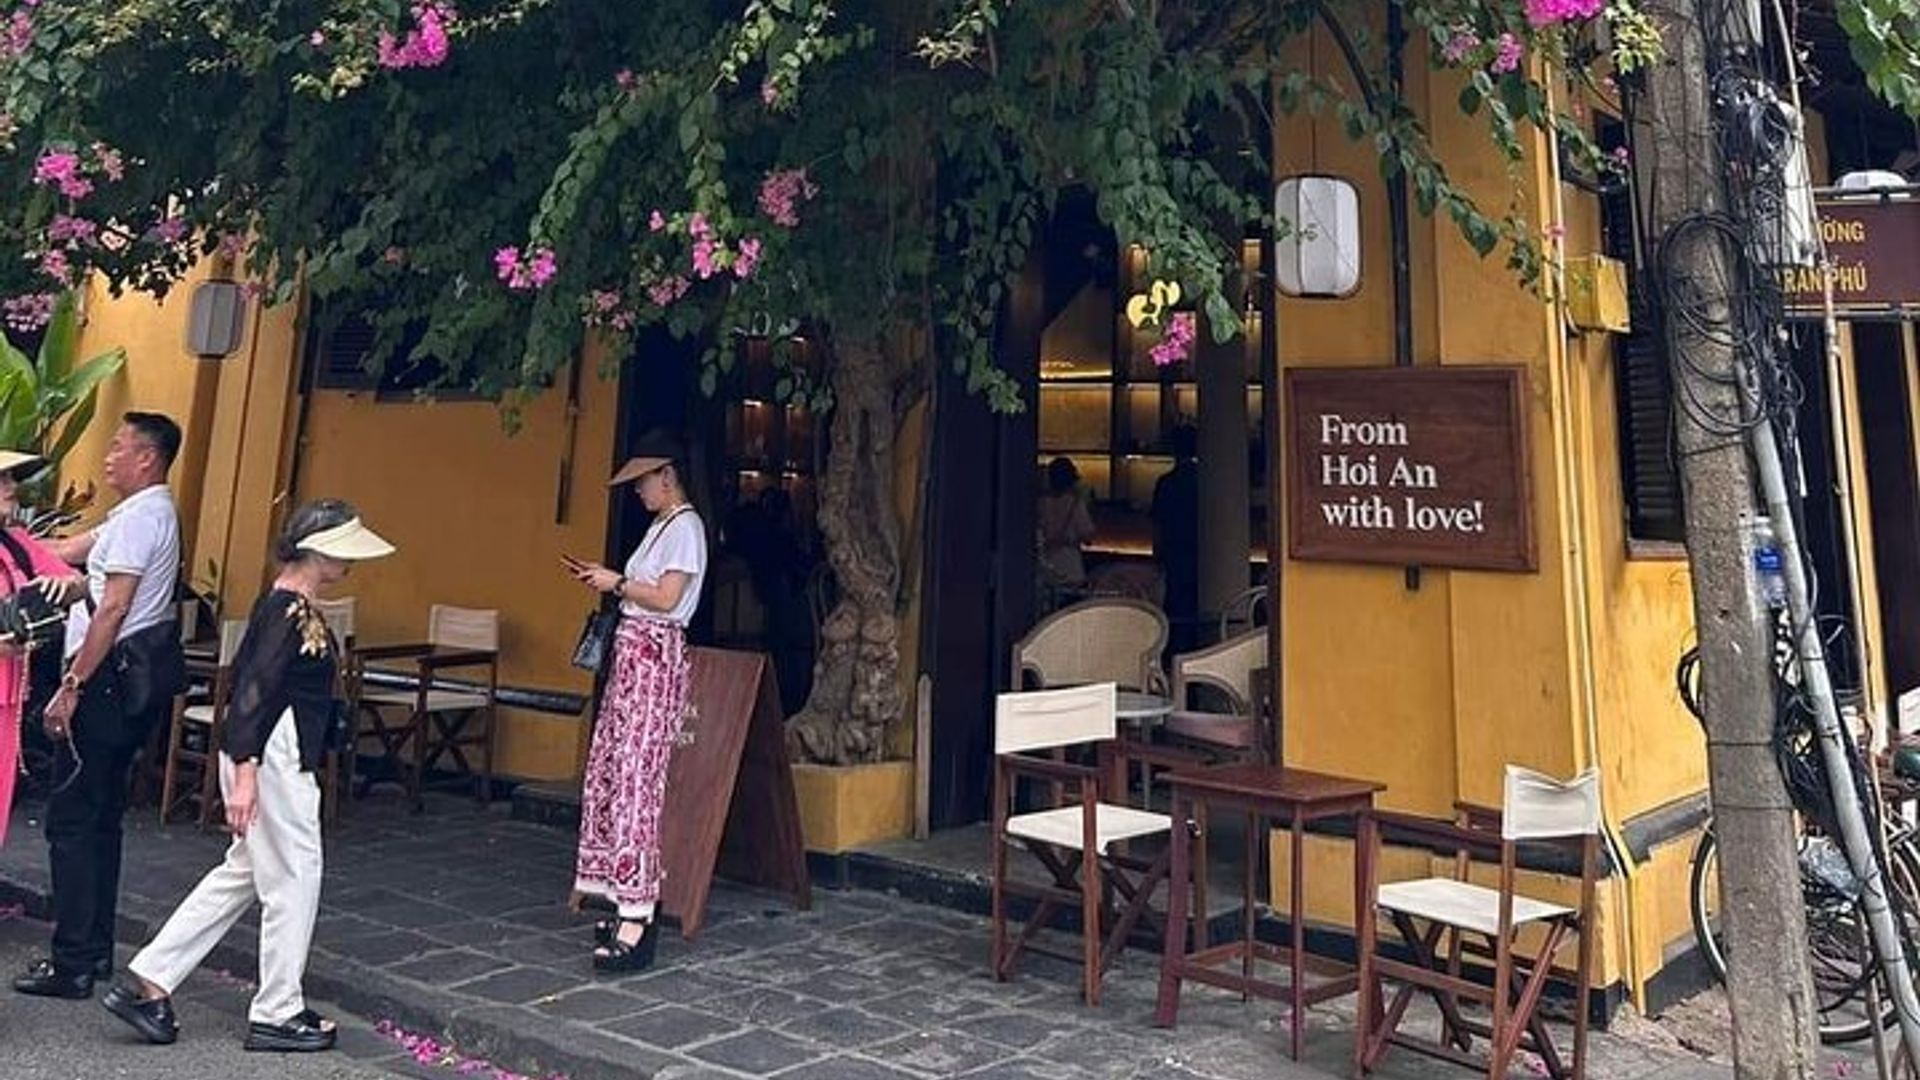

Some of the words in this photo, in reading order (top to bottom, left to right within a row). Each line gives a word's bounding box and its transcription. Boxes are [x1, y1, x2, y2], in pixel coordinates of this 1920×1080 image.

[1320, 414, 1409, 445] From
[1321, 454, 1378, 486] Hoi
[1388, 457, 1438, 488] An
[1320, 495, 1395, 529] with
[1405, 497, 1485, 532] love!
